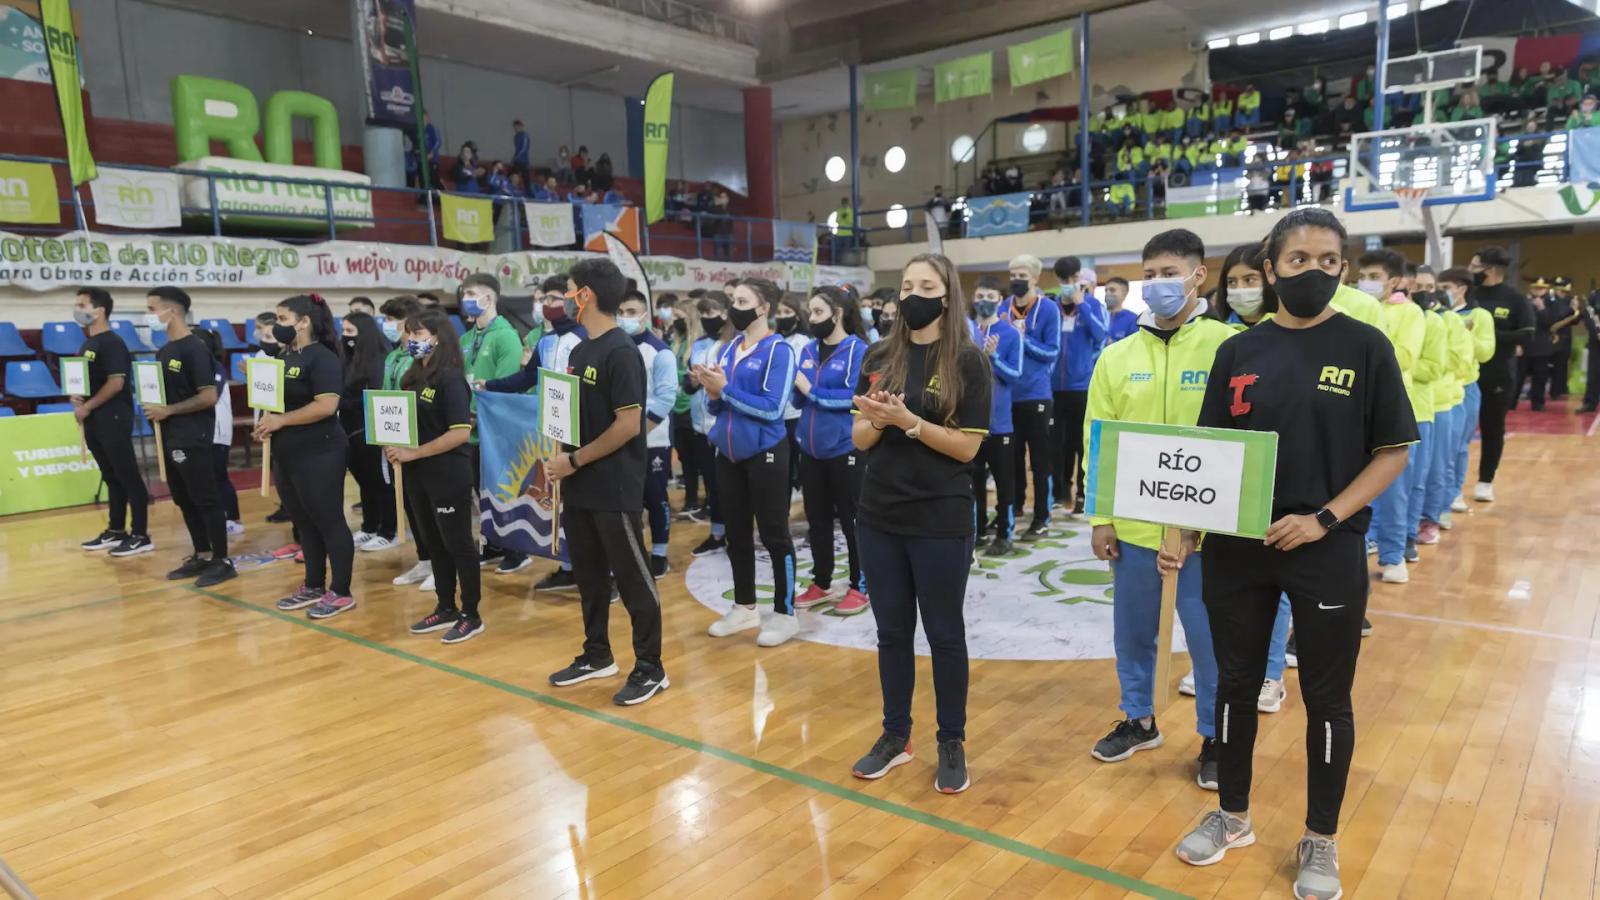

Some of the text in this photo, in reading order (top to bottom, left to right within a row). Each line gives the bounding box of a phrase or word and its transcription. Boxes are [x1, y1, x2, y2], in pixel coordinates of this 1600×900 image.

[118, 242, 150, 265] de
[212, 241, 300, 275] Negro
[307, 252, 340, 275] Tu
[346, 251, 399, 281] mejor
[0, 268, 33, 281] ara
[40, 265, 94, 281] Obras
[100, 266, 122, 281] de
[194, 268, 244, 283] Social
[1181, 370, 1209, 385] RN
[1318, 365, 1356, 388] RN
[380, 405, 403, 416] SANTA
[383, 421, 401, 432] CRUZ
[14, 445, 91, 462] TURISM
[1158, 448, 1202, 473] RÍO
[17, 466, 30, 478] Y
[1139, 479, 1217, 505] NEGRO
